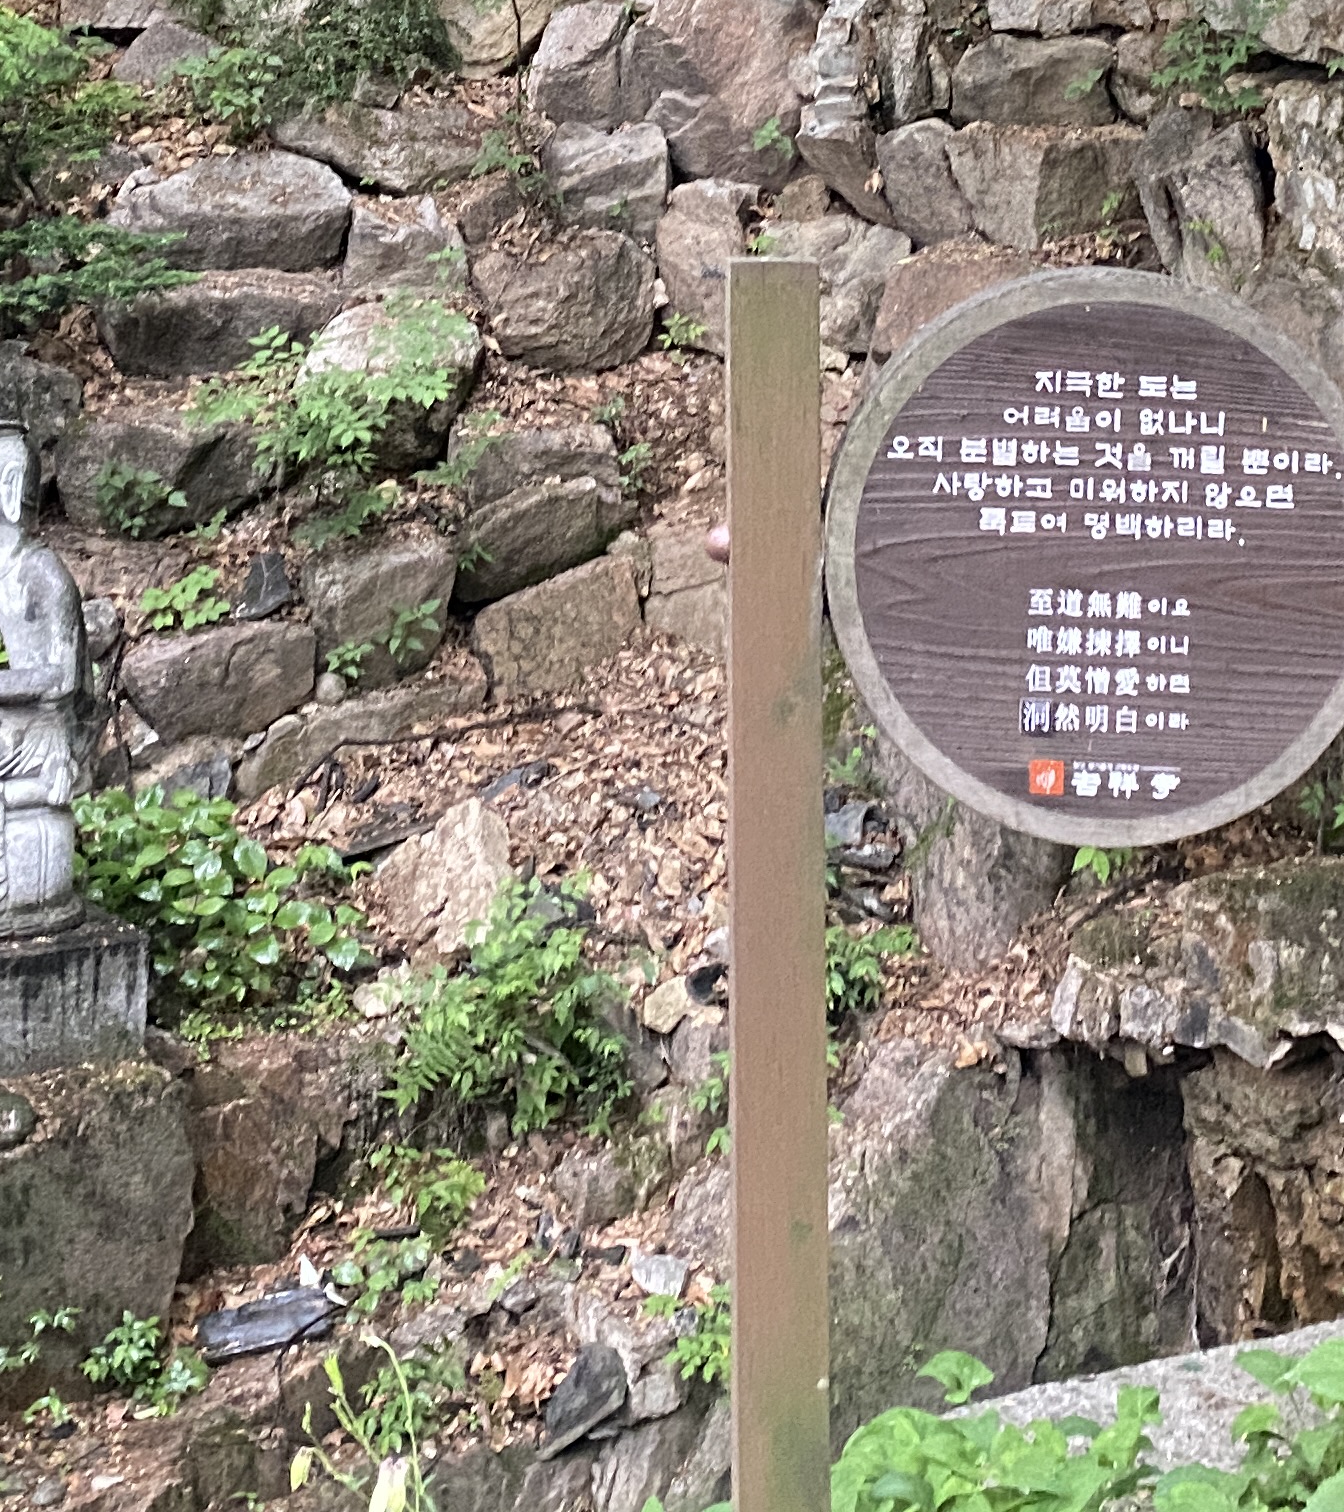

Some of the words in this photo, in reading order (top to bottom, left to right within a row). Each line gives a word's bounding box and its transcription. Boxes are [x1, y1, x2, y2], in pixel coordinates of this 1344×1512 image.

[1034, 369, 1126, 399] 지극한
[1138, 374, 1198, 401] 도는
[1003, 405, 1122, 433] 어려움이
[1139, 408, 1226, 437] 없나니
[886, 435, 944, 463] 오직
[959, 436, 1080, 467] 분별하는
[1094, 442, 1152, 472] 것을
[1168, 445, 1226, 475] 꺼릴
[1241, 447, 1342, 480] 뿐이라.
[932, 471, 1053, 502] 사랑하고
[1069, 476, 1189, 504] 미워하지
[1205, 481, 1295, 510] 않으면
[1084, 511, 1245, 547] 명백하리라.
[1027, 588, 1191, 620] 至道無難이요
